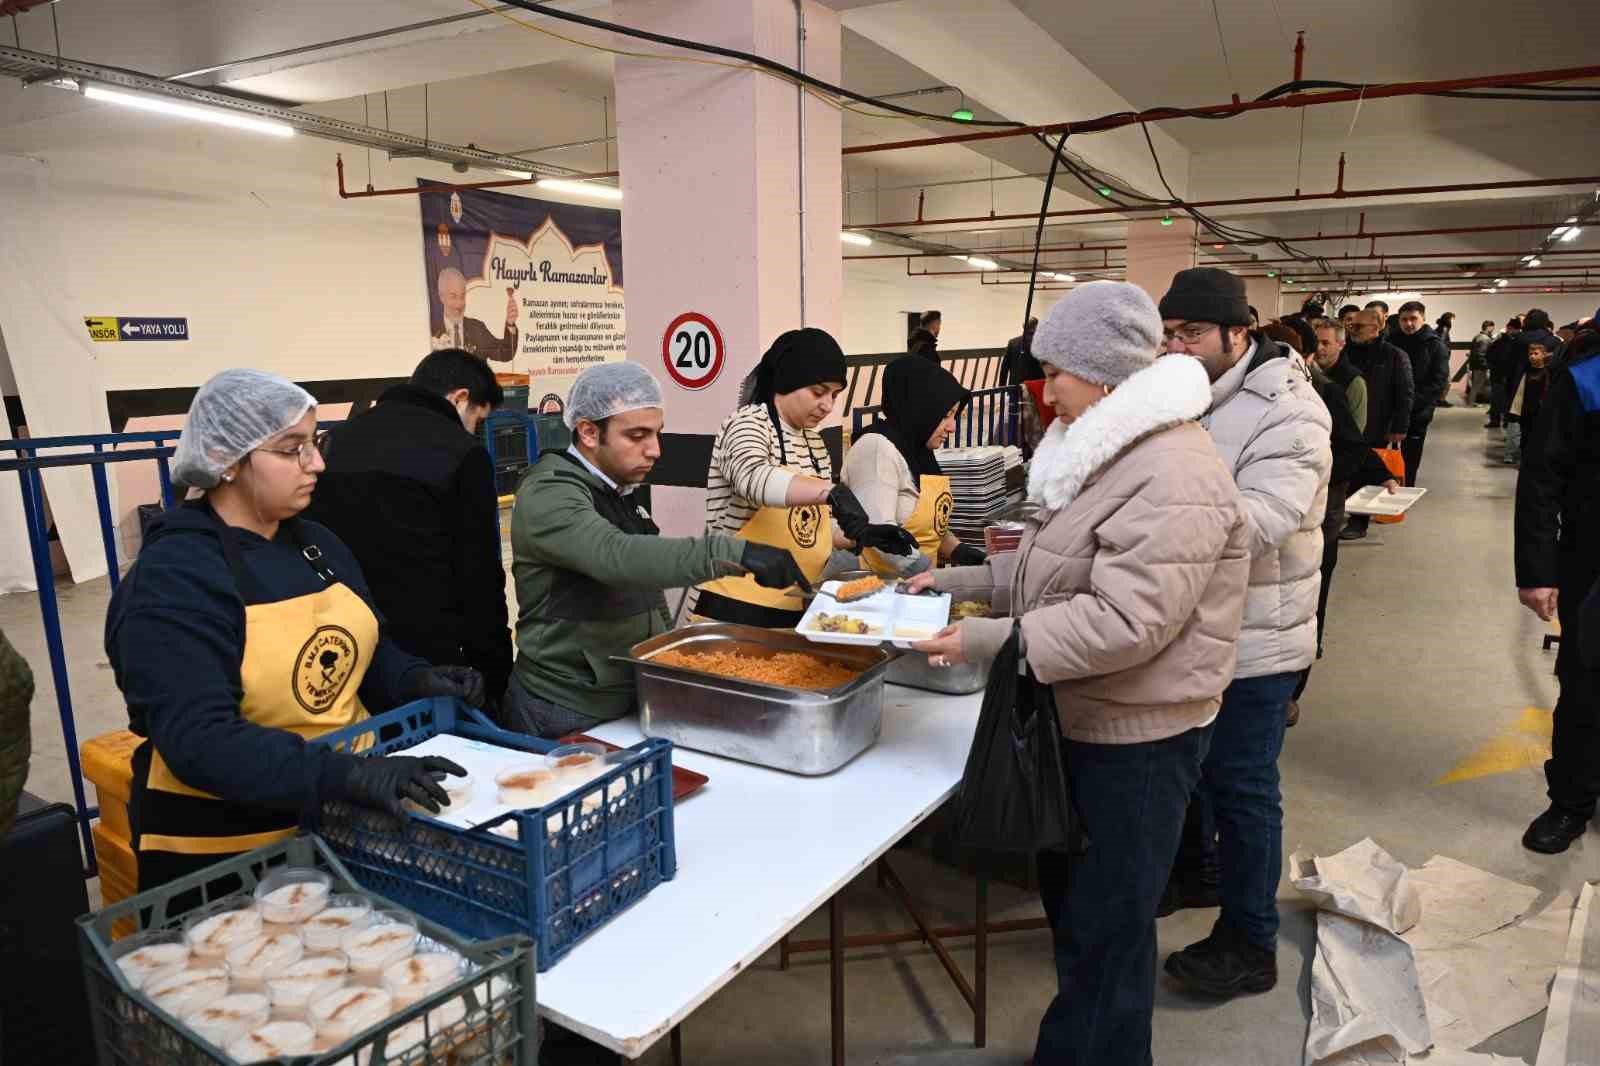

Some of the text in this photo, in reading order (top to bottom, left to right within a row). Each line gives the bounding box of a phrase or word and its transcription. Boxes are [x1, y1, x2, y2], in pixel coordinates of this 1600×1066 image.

[491, 256, 608, 289] Hayırlı Ramazanlar
[522, 298, 548, 307] Ramazan
[140, 324, 185, 335] YAYA YOLU
[675, 331, 710, 368] 20
